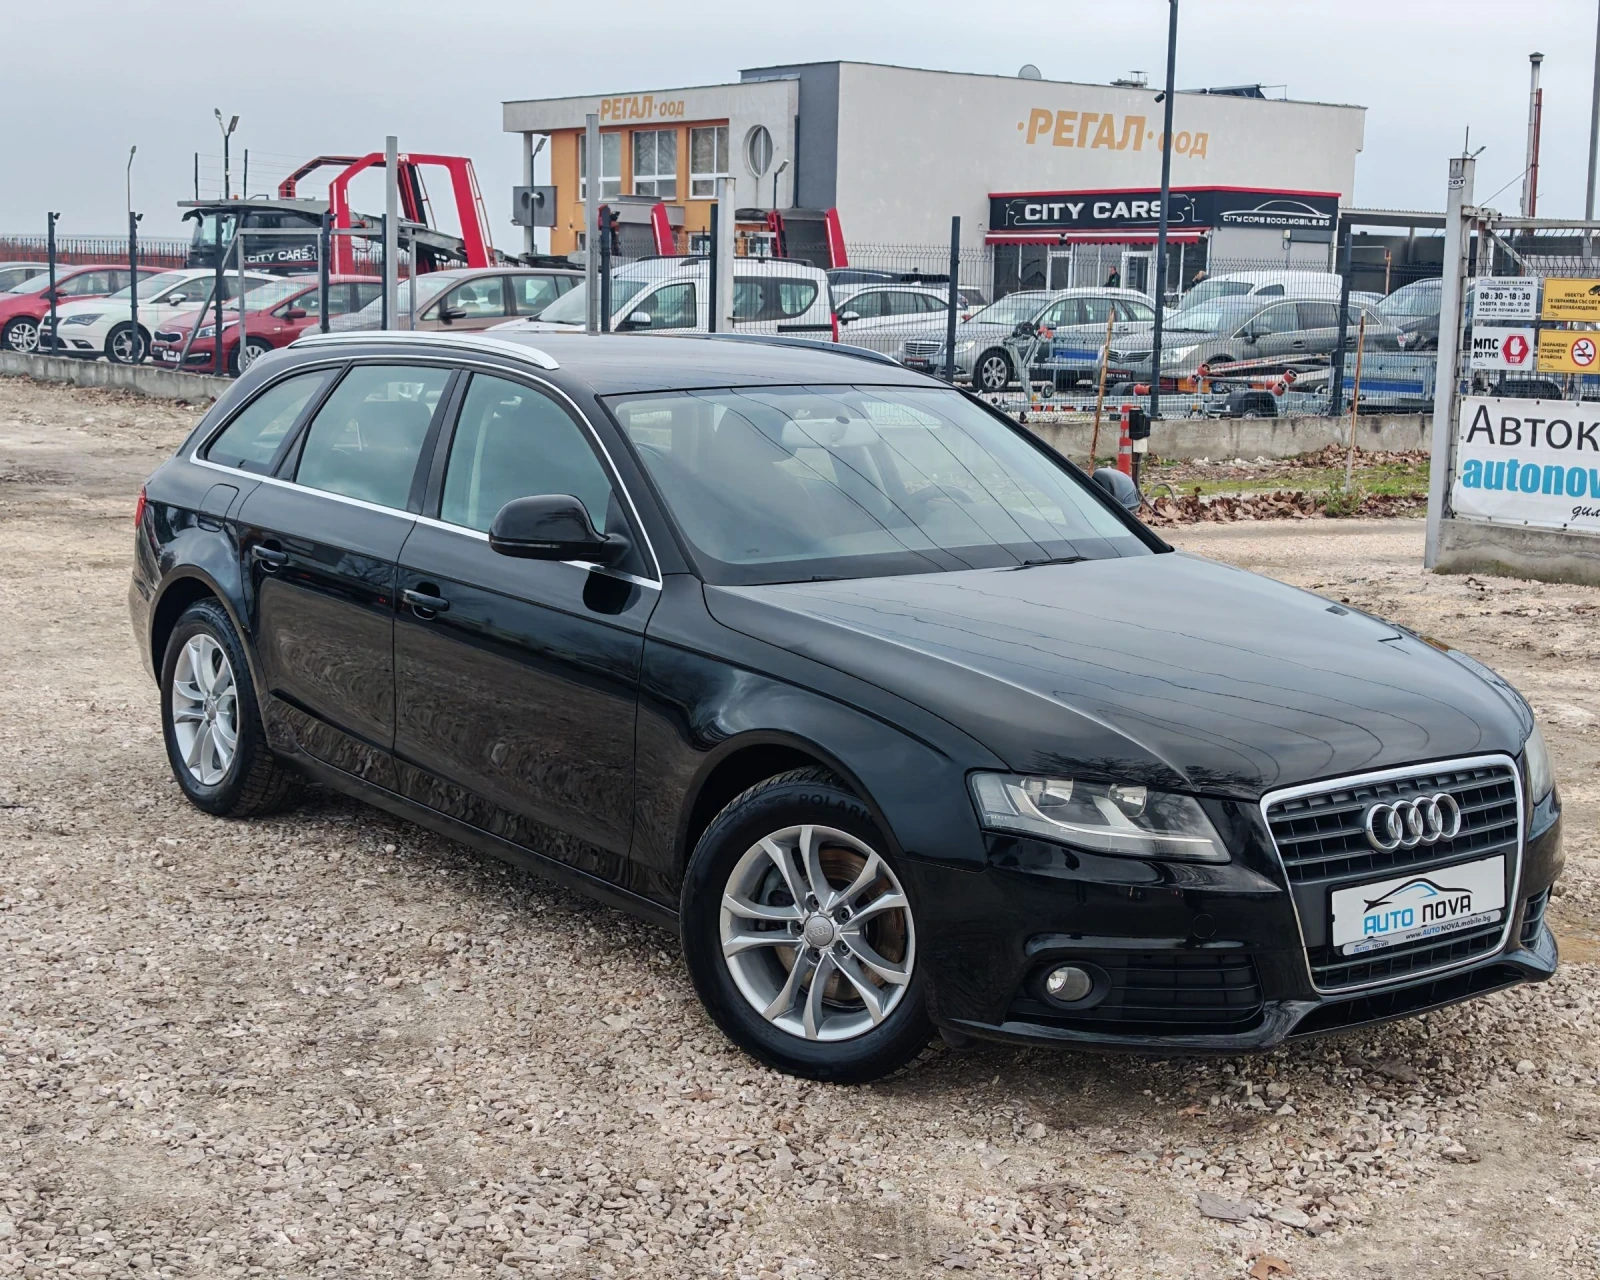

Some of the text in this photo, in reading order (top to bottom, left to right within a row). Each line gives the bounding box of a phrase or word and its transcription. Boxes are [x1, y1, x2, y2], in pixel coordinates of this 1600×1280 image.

[1025, 200, 1161, 220] CITY CARS
[246, 248, 308, 263] CITY CARS
[1474, 338, 1498, 350] МПС
[1364, 895, 1471, 935] AUTO NOVA
